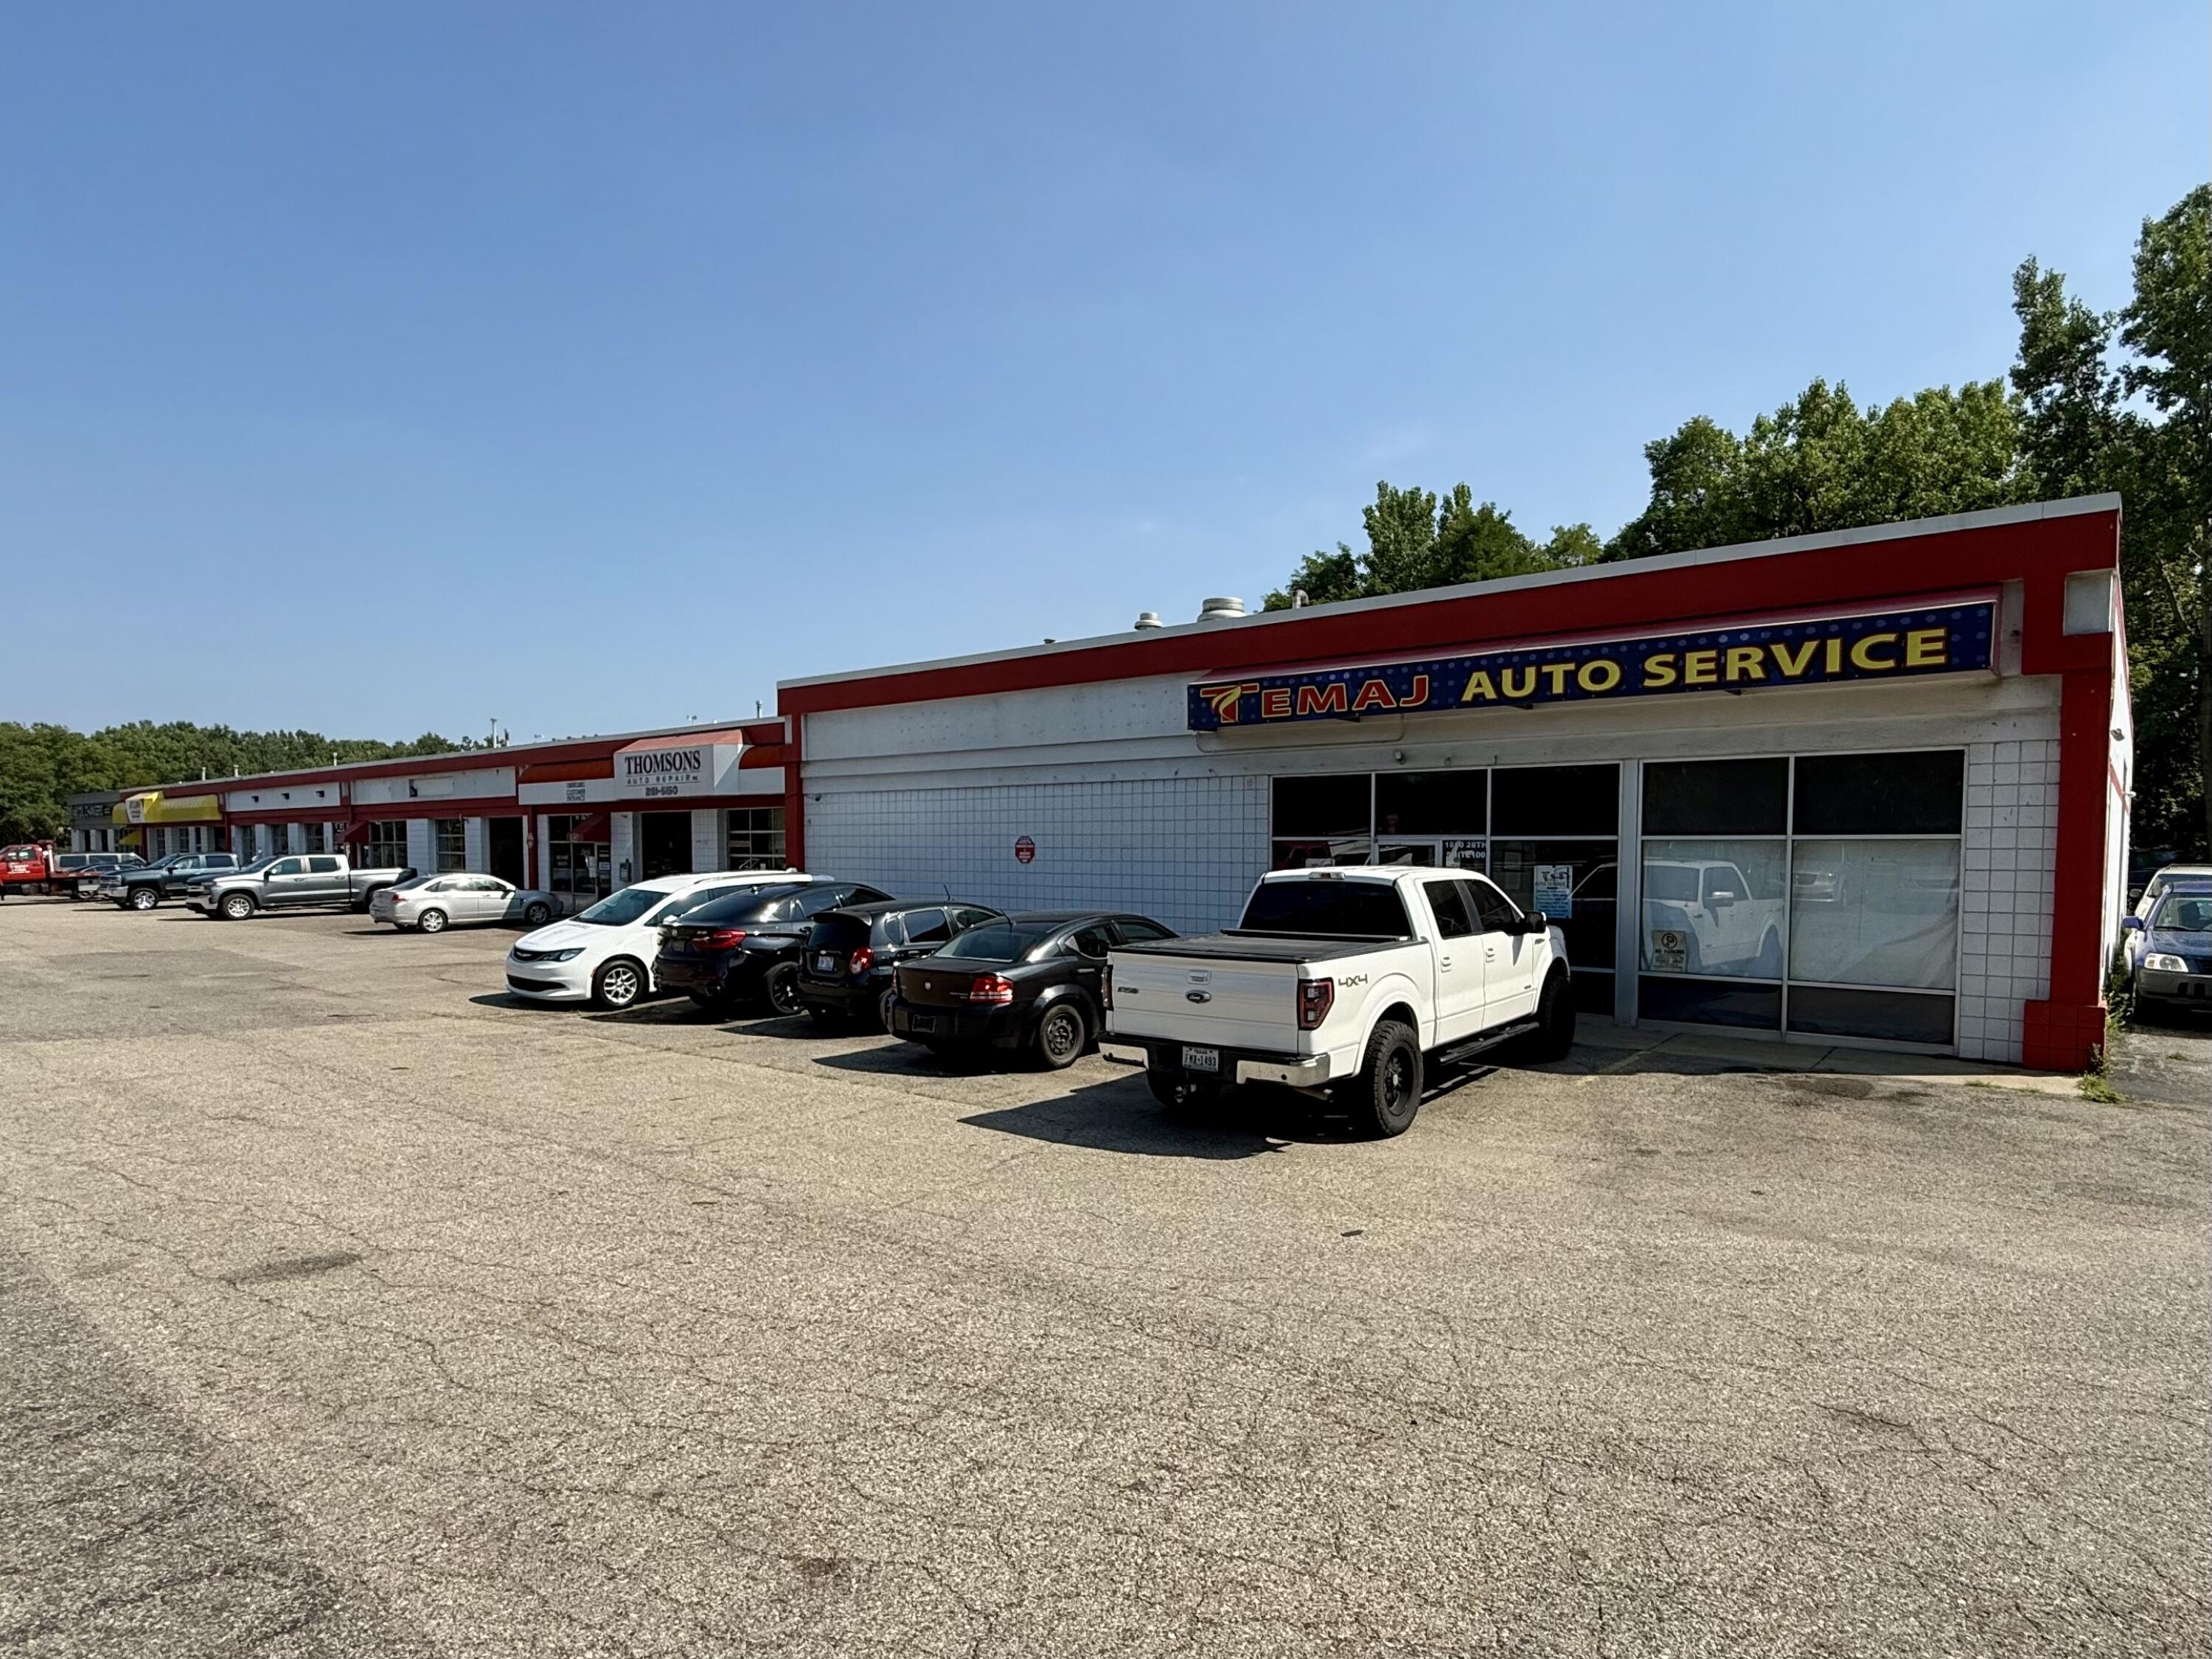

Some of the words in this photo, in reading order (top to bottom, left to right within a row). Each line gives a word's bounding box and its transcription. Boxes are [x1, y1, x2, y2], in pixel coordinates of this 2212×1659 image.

[1200, 675, 1429, 723] TEMAJ
[1460, 659, 1621, 702] AUTO
[1644, 627, 1947, 687] SERVICE
[625, 750, 701, 775] THOMSONS
[627, 776, 650, 785] AUTO
[655, 774, 690, 783] REPAIR
